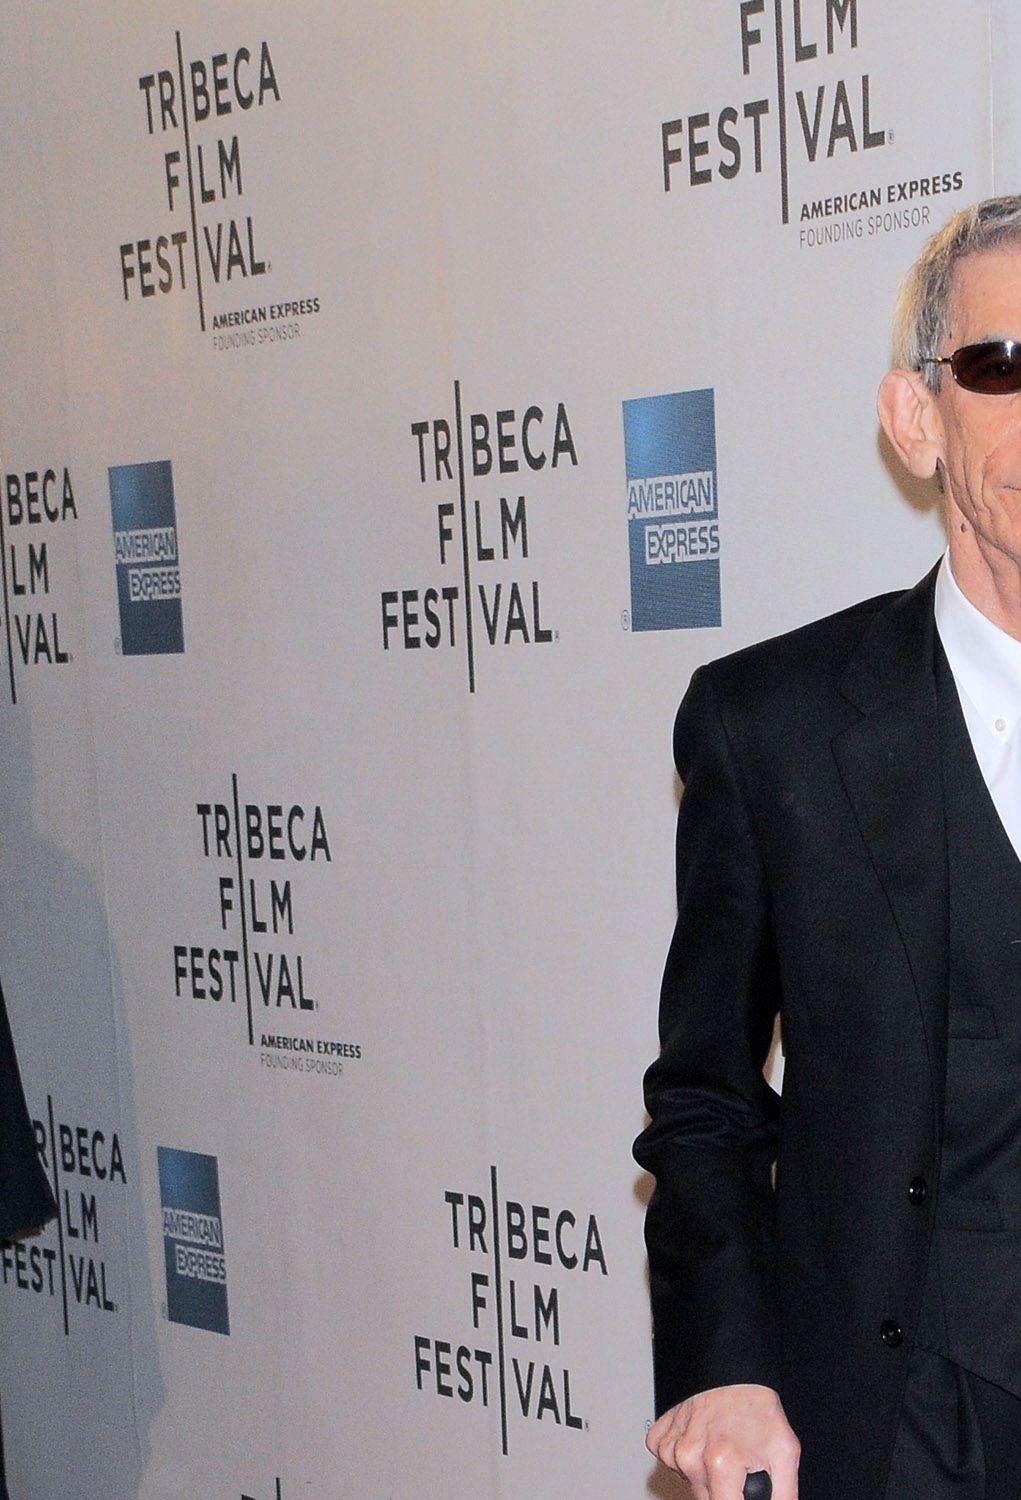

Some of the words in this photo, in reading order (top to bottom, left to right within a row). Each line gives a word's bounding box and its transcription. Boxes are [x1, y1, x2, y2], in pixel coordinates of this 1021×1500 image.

[740, 0, 858, 75] FILM
[139, 41, 281, 134] TRIBECA
[661, 74, 885, 192] FESTIVAL
[164, 135, 243, 211] FILM
[800, 187, 881, 222] AMERICAN
[887, 171, 963, 203] EXPRESS
[799, 219, 863, 248] FOUNDING
[868, 205, 931, 237] SPONSOR
[119, 216, 267, 300] FESTIVAL
[212, 305, 267, 330] AMERICAN
[269, 297, 321, 322] EXPRESS
[212, 328, 256, 351] FOUNDING
[257, 322, 301, 345] SPONSOR
[411, 402, 578, 482] TRIBECA
[0, 467, 78, 525] BECA
[627, 476, 711, 515] AMERICAN
[115, 529, 175, 562] AMERICAN
[437, 496, 529, 565] FILM
[648, 524, 720, 560] EXPRESS
[2, 542, 49, 595] ILM
[131, 569, 181, 598] EXPRESS
[381, 581, 553, 650] FESTIVAL
[196, 803, 332, 862] TRIBECA
[219, 877, 293, 935] FILM
[173, 945, 314, 1011] FESTIVAL
[260, 1033, 314, 1054] AMERICAN
[317, 1040, 362, 1060] EXPRESS
[305, 1056, 344, 1077] SPONSOR
[32, 1120, 127, 1184] RIBECA
[43, 1189, 98, 1243] ILM
[162, 1206, 221, 1247] AMERICAN
[444, 1190, 608, 1275] TRIBECA
[178, 1250, 226, 1281] EXPRESS
[471, 1272, 560, 1346] FILM
[414, 1335, 583, 1430] FESTIVAL
